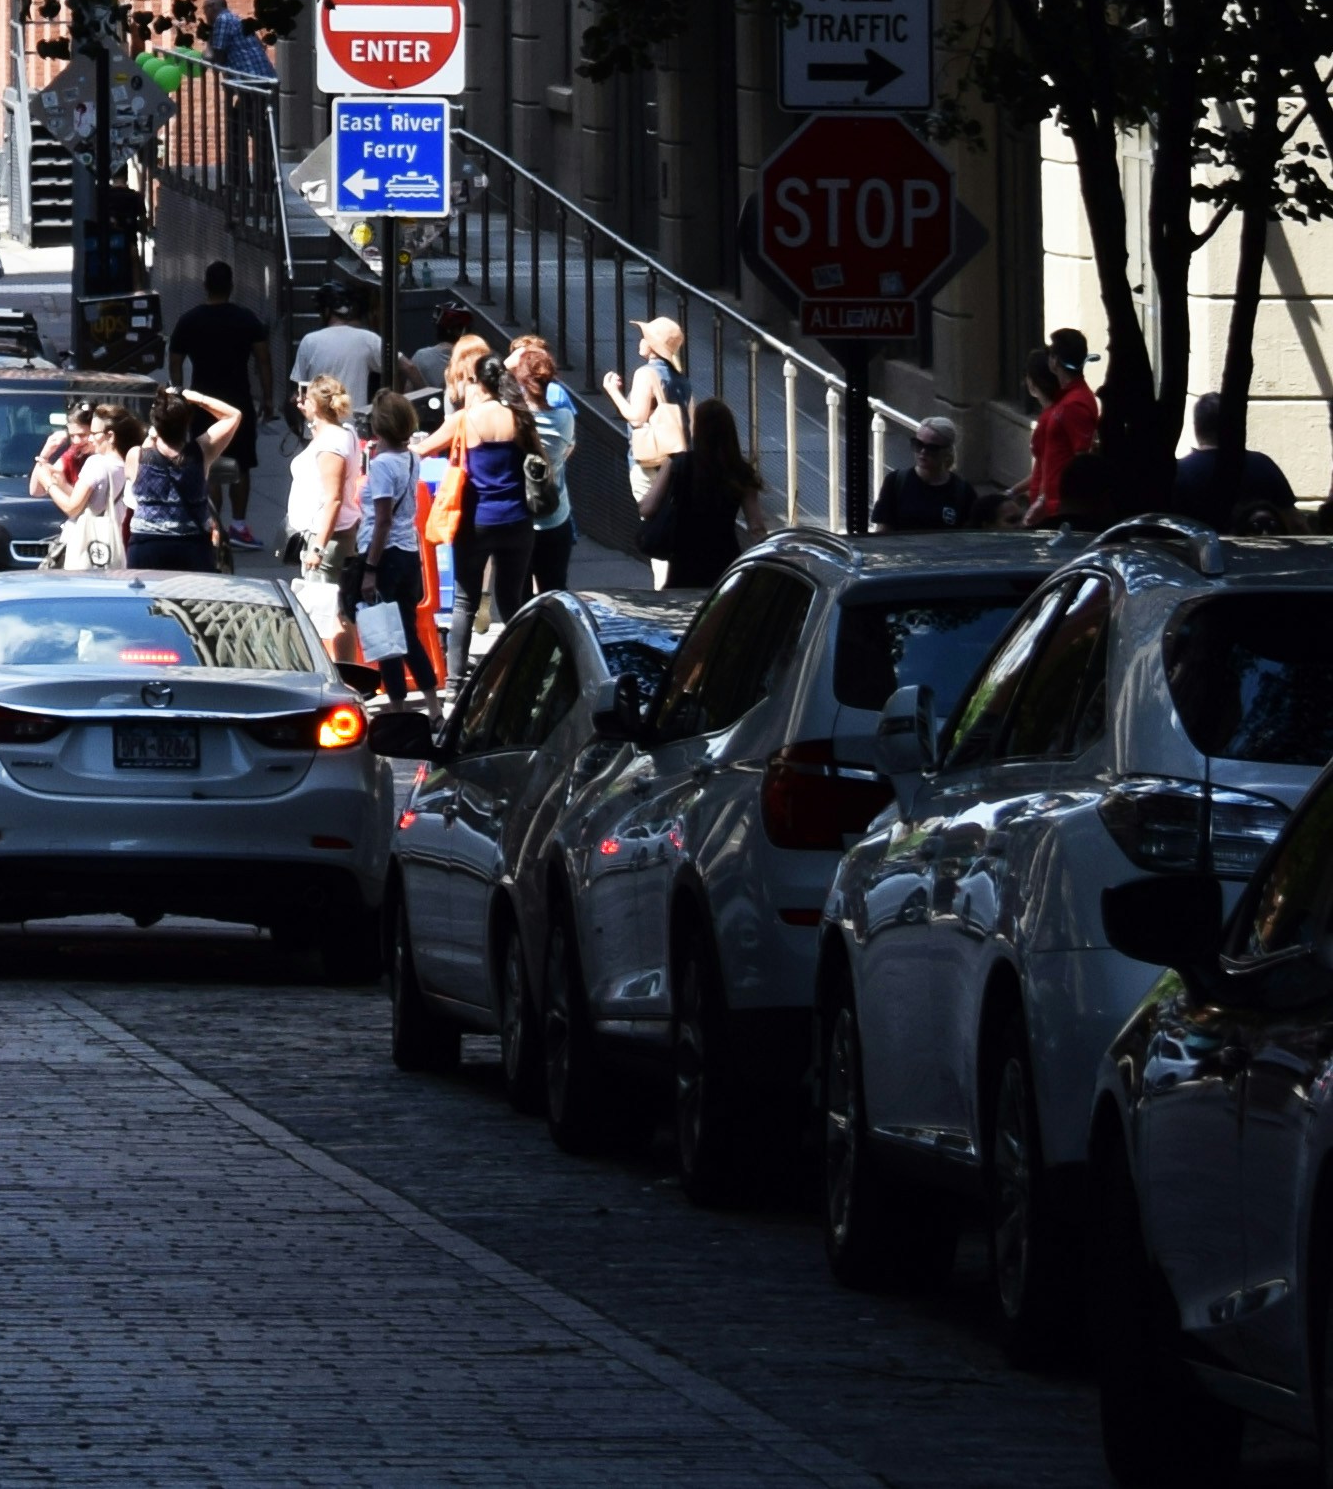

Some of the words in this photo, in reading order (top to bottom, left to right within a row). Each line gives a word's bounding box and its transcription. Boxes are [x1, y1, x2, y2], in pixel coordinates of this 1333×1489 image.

[804, 14, 908, 42] TRAFFIC
[351, 39, 430, 62] ENTER
[340, 114, 381, 131] East
[391, 113, 442, 132] River
[364, 141, 417, 162] Ferry
[773, 176, 941, 249] STOP
[810, 306, 846, 328] ALL
[862, 306, 907, 328] WAY
